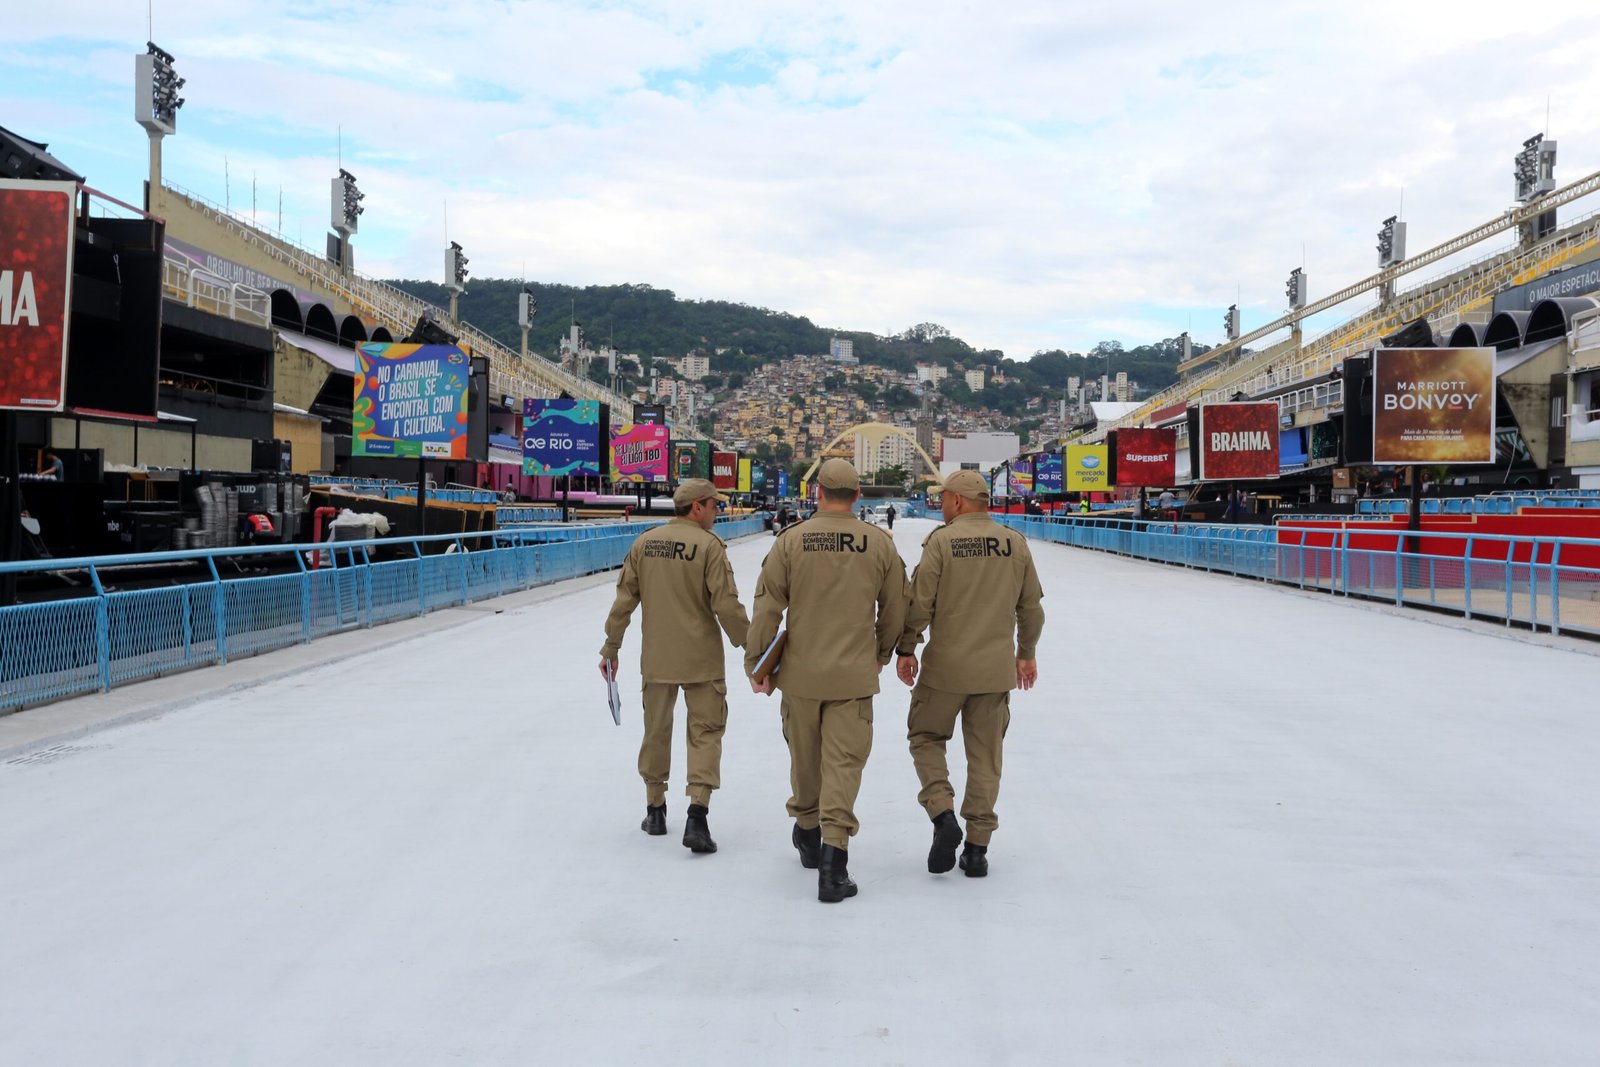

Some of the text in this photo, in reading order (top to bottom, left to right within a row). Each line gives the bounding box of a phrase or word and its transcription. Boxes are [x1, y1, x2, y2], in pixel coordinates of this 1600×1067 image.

[206, 255, 244, 283] ORGULHO
[246, 270, 255, 287] DE
[1530, 290, 1536, 302] O
[1536, 282, 1560, 300] MAIOR
[378, 360, 443, 384] NO CARNAVAL,
[378, 378, 436, 402] O BRASIL SE
[1397, 382, 1466, 390] MARRIOTT
[382, 395, 454, 420] ENCONTRA COM
[1384, 394, 1478, 410] BONVOY
[393, 415, 446, 438] A CULTURA.
[550, 438, 573, 450] RIO
[1211, 431, 1271, 452] BRAHMA
[645, 448, 662, 462] 180
[1126, 454, 1168, 462] SUPERBET
[673, 542, 697, 561] RJ
[840, 533, 867, 553] RJ
[986, 537, 1012, 557] RJ
[952, 550, 983, 558] MILITAR
